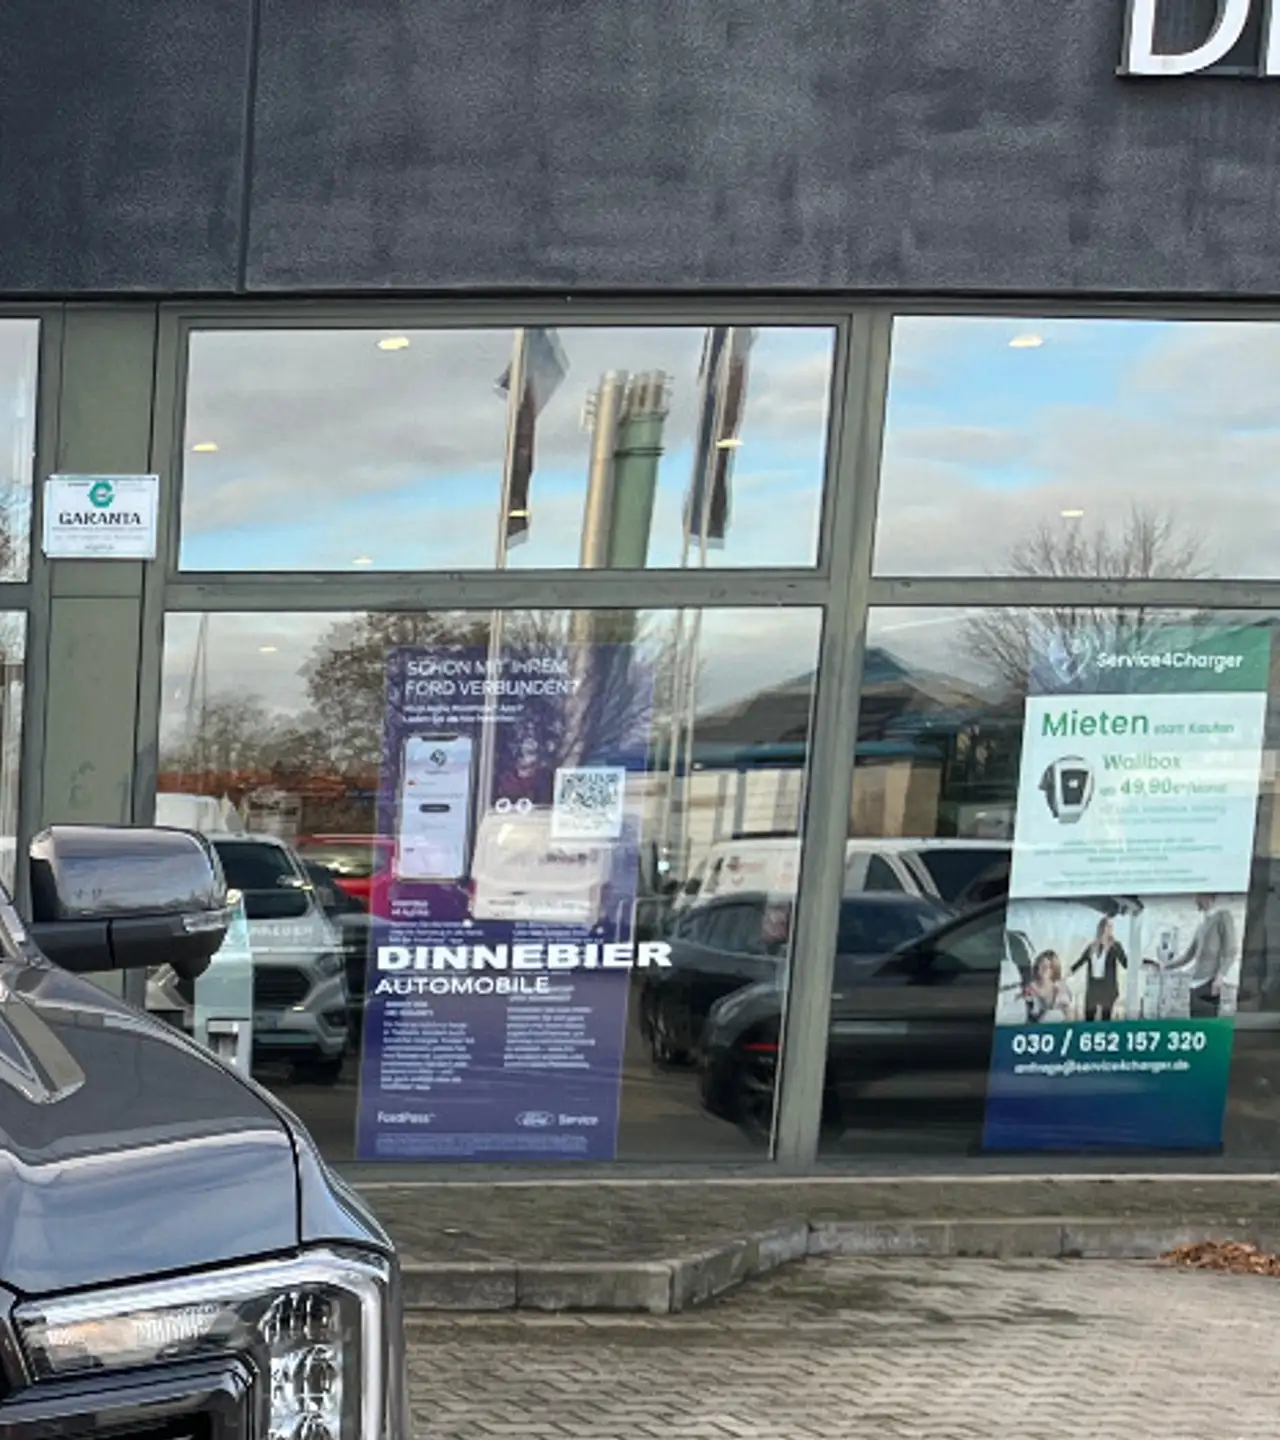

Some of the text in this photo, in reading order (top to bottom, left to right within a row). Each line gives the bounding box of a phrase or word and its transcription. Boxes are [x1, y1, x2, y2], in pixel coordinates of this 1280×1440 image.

[58, 511, 142, 526] GARANTA
[407, 659, 473, 677] SCHON
[474, 659, 504, 675] MT
[1096, 651, 1244, 674] Service4Charger
[404, 679, 456, 697] FORD
[1041, 709, 1149, 737] Mieten
[1103, 753, 1182, 771] Wallbox
[376, 941, 673, 971] DINNEBIER
[374, 975, 550, 996] AUTOMOBILE
[1011, 1028, 1207, 1057] 030 / 652 157 320
